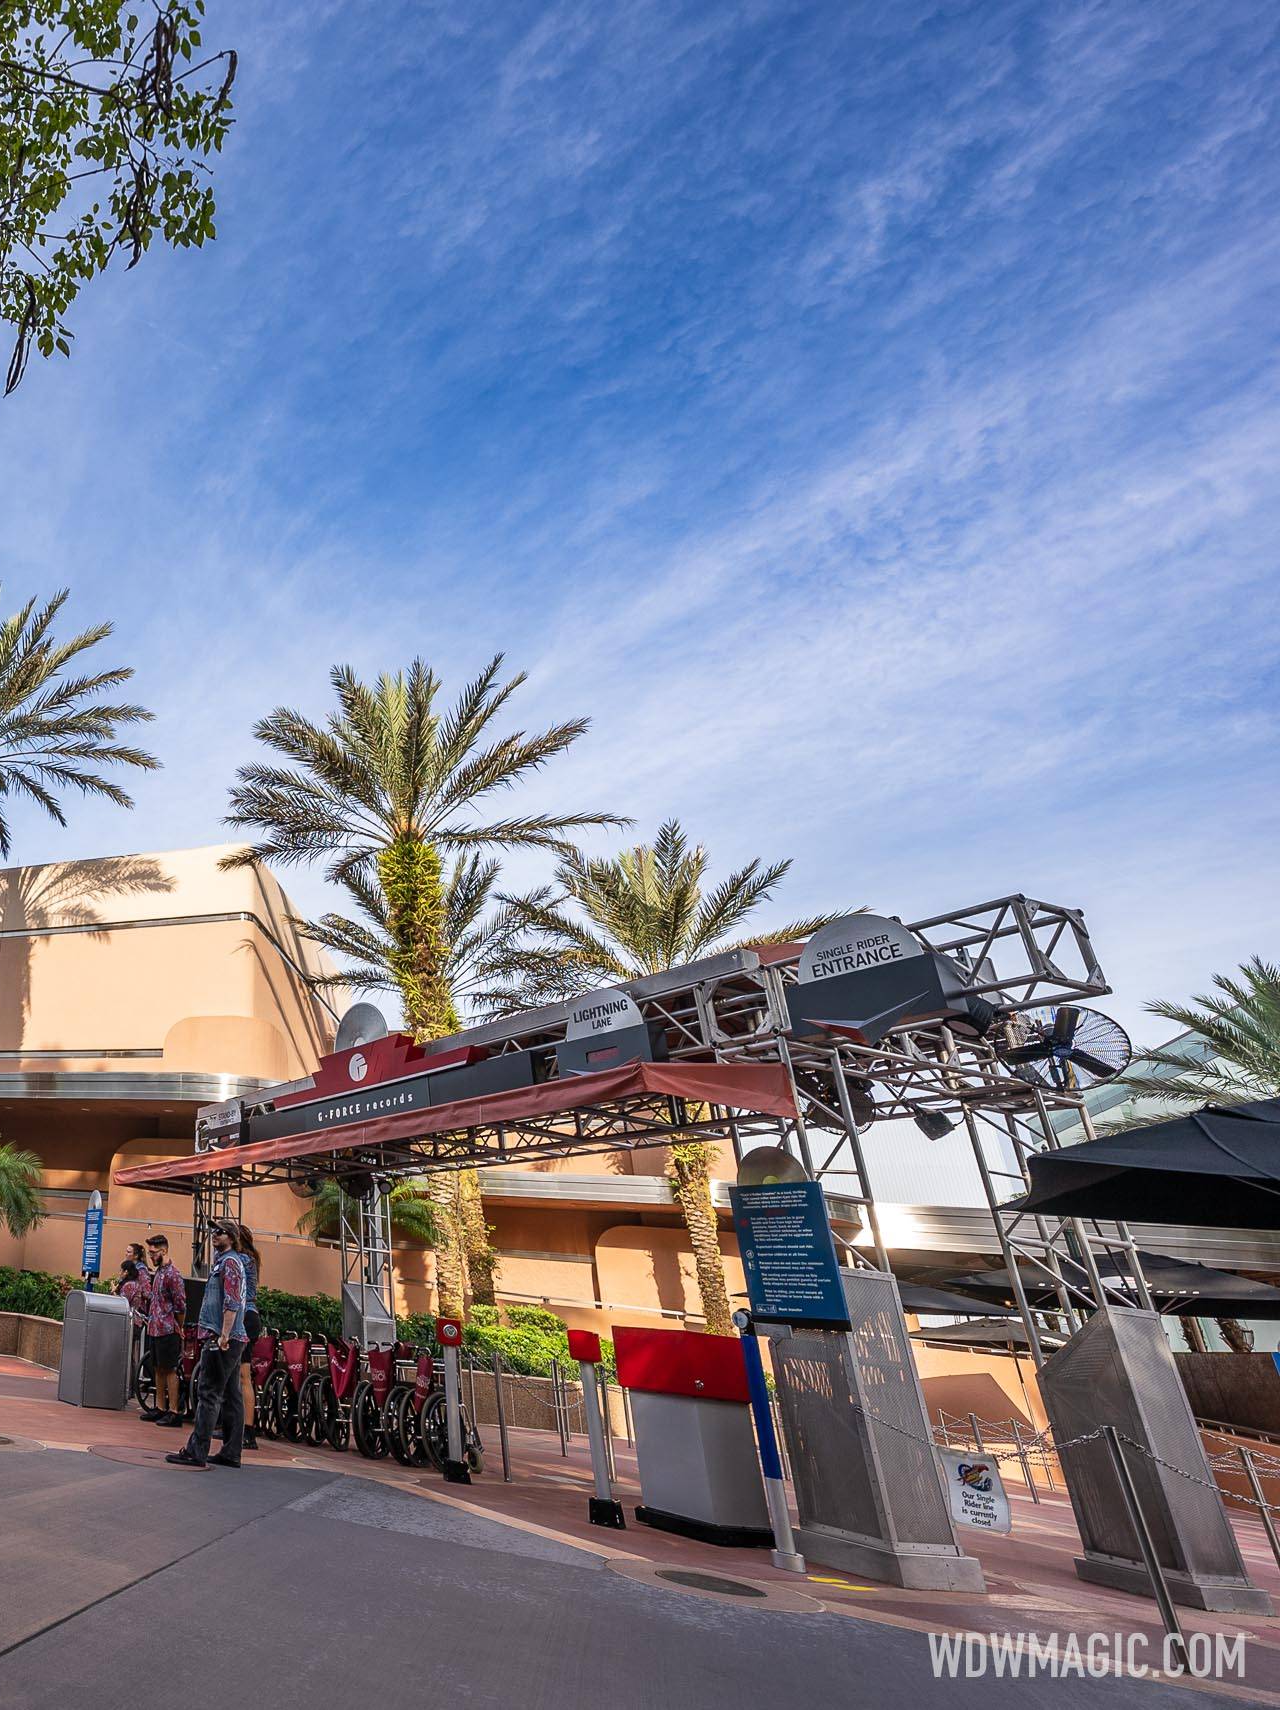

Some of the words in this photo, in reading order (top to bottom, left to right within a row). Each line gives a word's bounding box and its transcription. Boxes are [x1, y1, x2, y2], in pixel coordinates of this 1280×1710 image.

[816, 943, 854, 961] SINGLE
[856, 934, 890, 951] RIDER
[811, 943, 903, 978] ENTRANCE
[573, 999, 628, 1023] LIGHTNING
[592, 1017, 612, 1029] LANE
[366, 1093, 413, 1111] records
[961, 1491, 975, 1499] Our
[976, 1493, 995, 1504] Single
[964, 1499, 981, 1508] Rider
[983, 1503, 994, 1511] line
[970, 1510, 997, 1521] currently
[972, 1517, 991, 1526] closed
